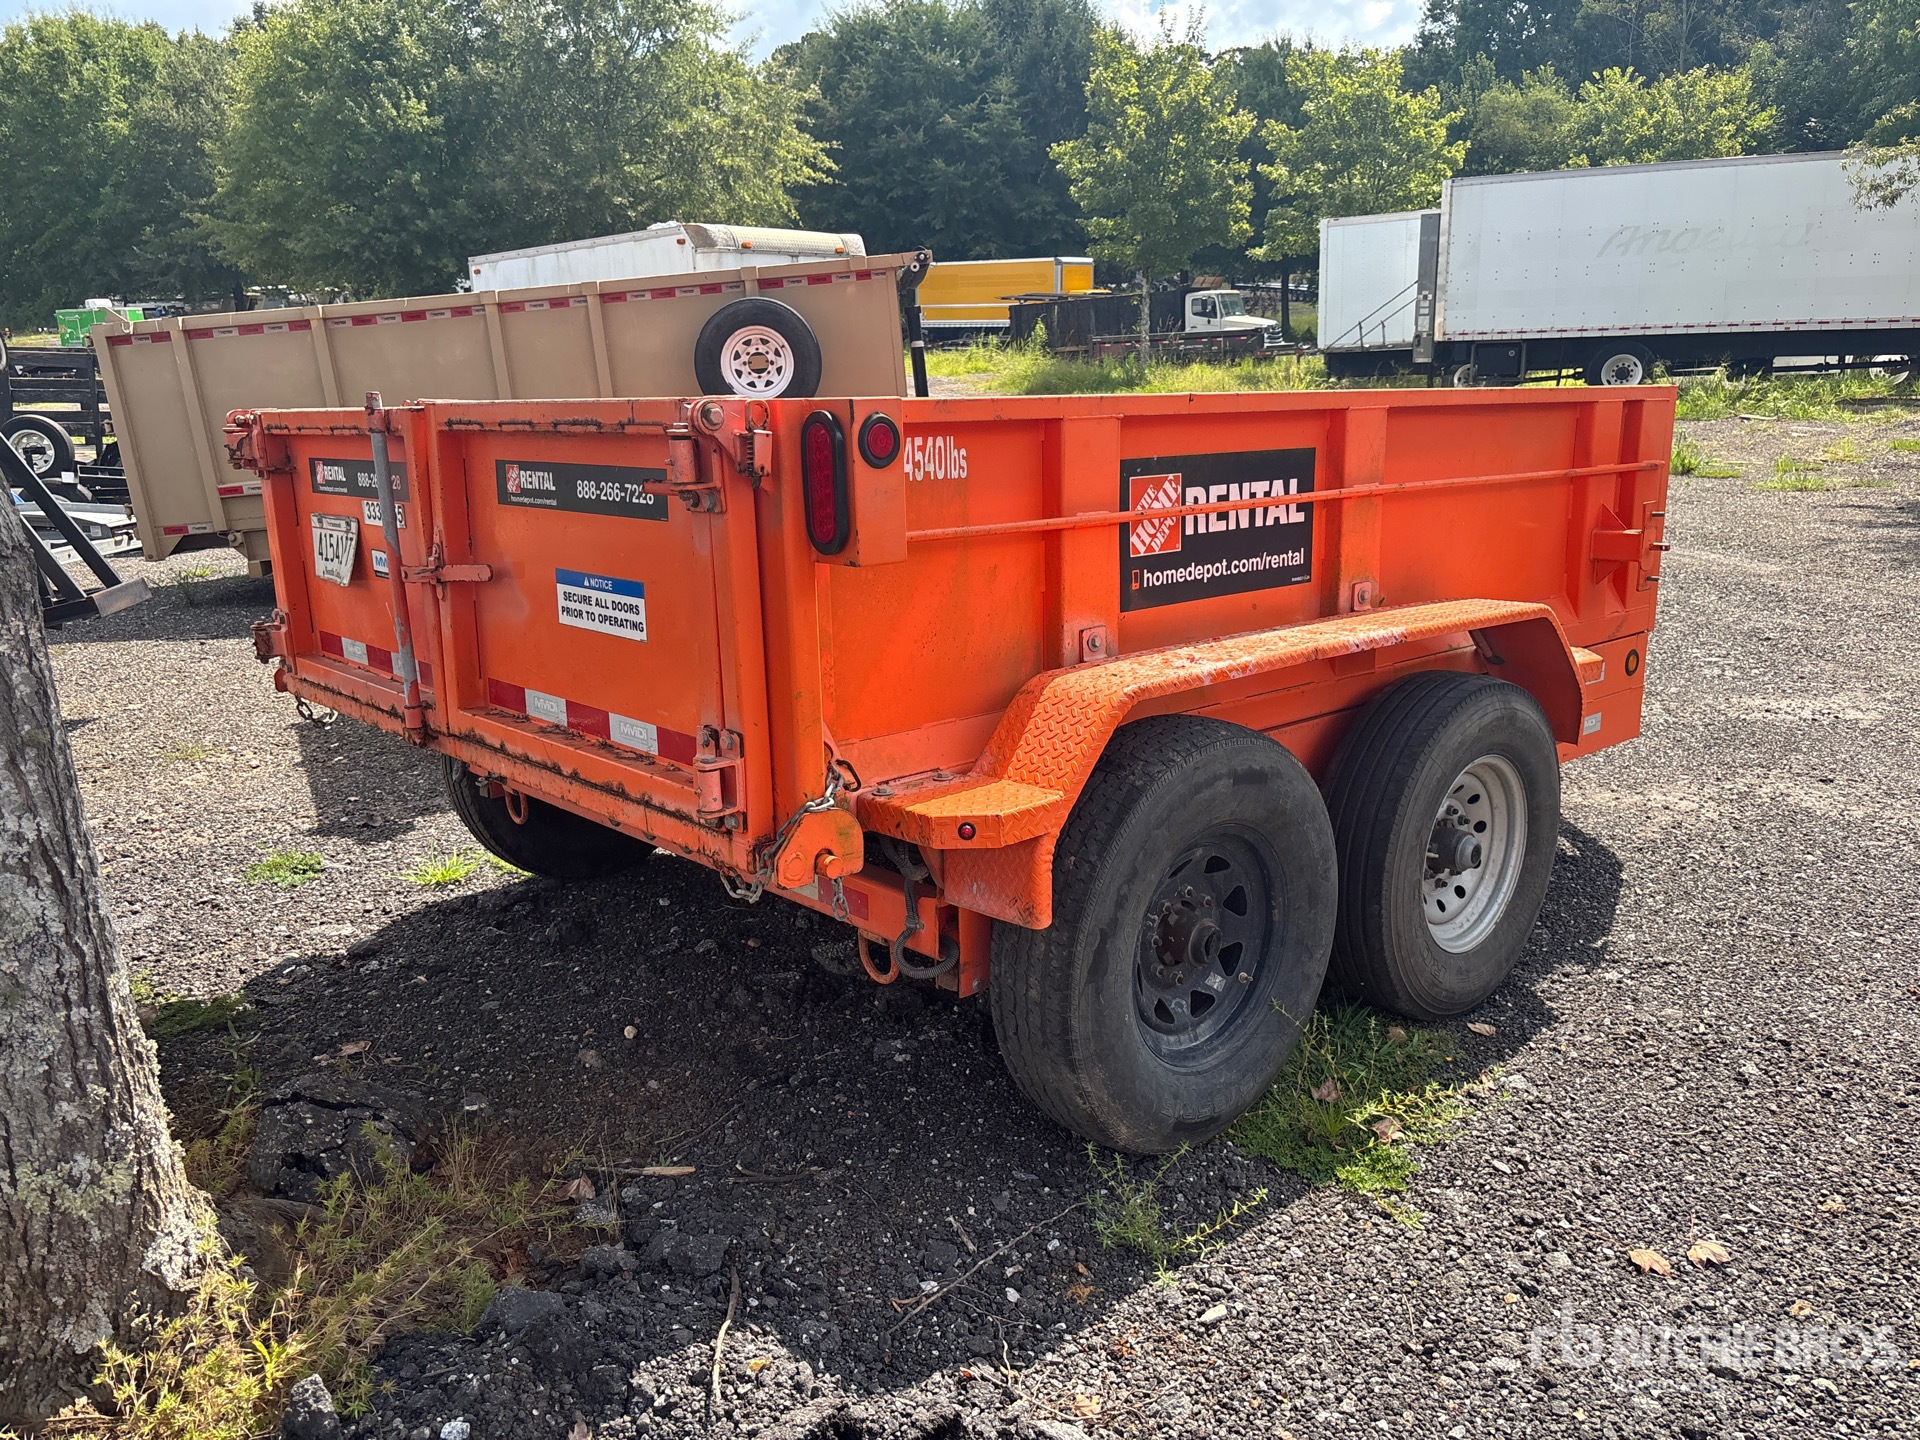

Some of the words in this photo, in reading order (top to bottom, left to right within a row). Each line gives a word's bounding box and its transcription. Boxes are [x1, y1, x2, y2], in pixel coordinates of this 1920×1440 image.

[904, 435, 967, 481] 4540lbs
[323, 465, 347, 482] RENTAL
[519, 470, 556, 491] RENTAL
[1185, 478, 1305, 536] RENTAL
[1143, 547, 1305, 588] homedepot.com/rental
[589, 577, 613, 591] NOTICE
[562, 590, 593, 606] SECURE
[594, 597, 610, 610] ALL
[611, 600, 640, 616] DOORS
[561, 605, 584, 620] PRIOR
[585, 610, 596, 622] TO
[597, 613, 645, 633] OPERATING
